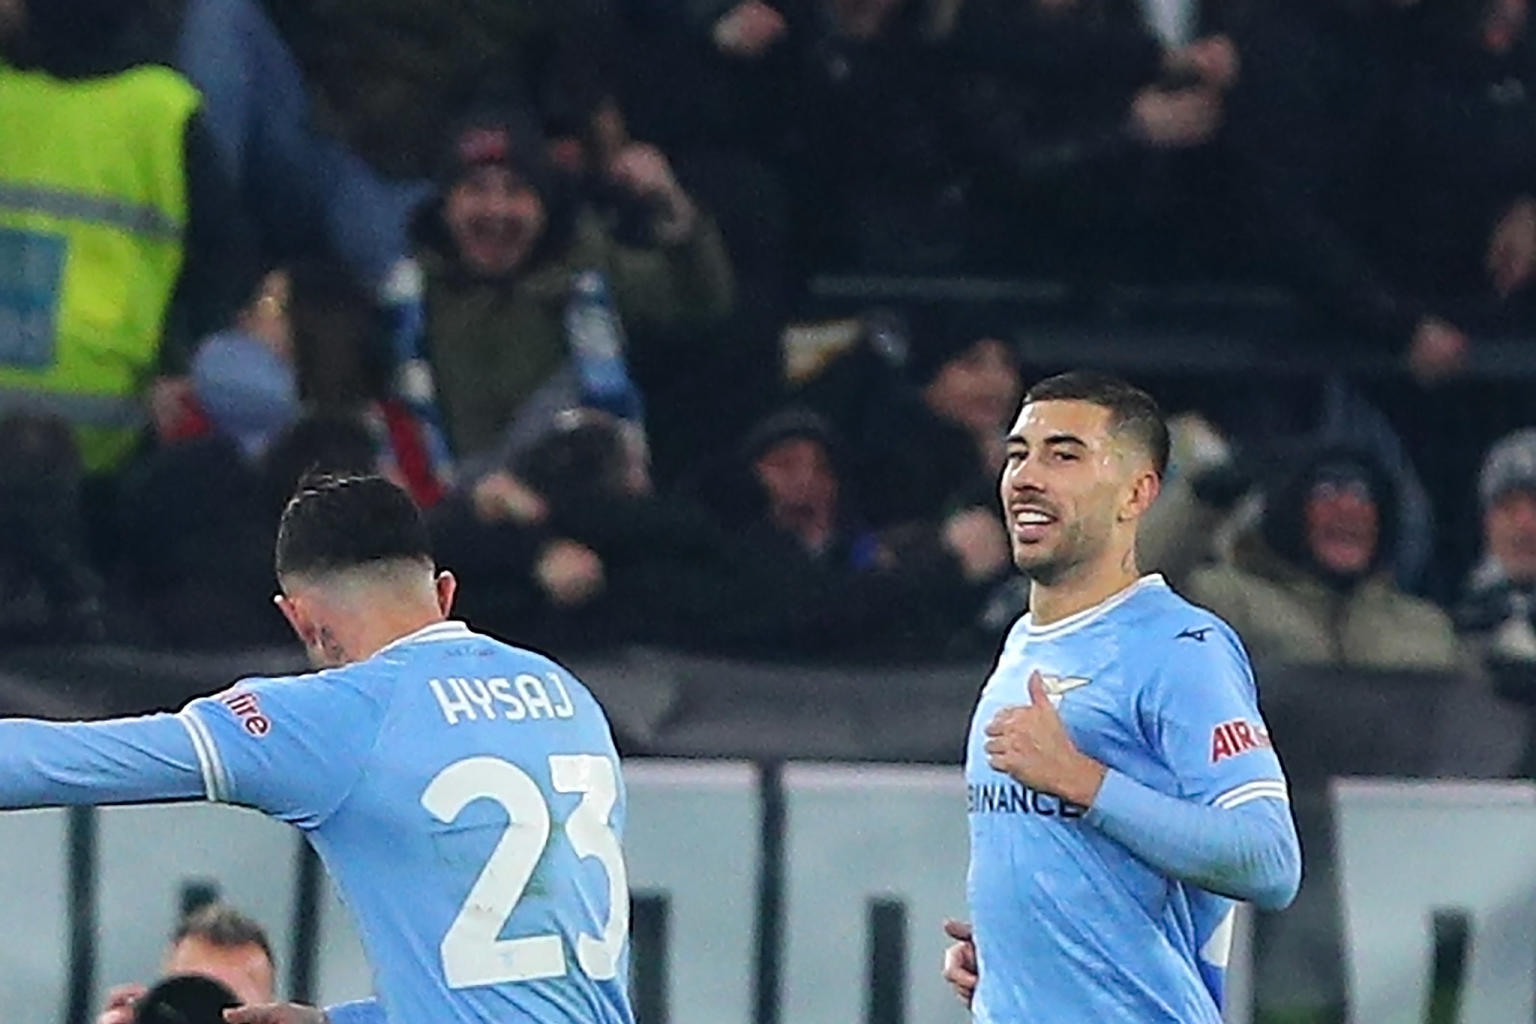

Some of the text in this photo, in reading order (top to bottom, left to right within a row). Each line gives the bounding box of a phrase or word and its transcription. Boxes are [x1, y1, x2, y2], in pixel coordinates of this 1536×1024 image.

[224, 692, 269, 735] fire
[427, 671, 574, 726] HYSAJ
[1211, 720, 1270, 763] AIR
[419, 752, 631, 990] 23
